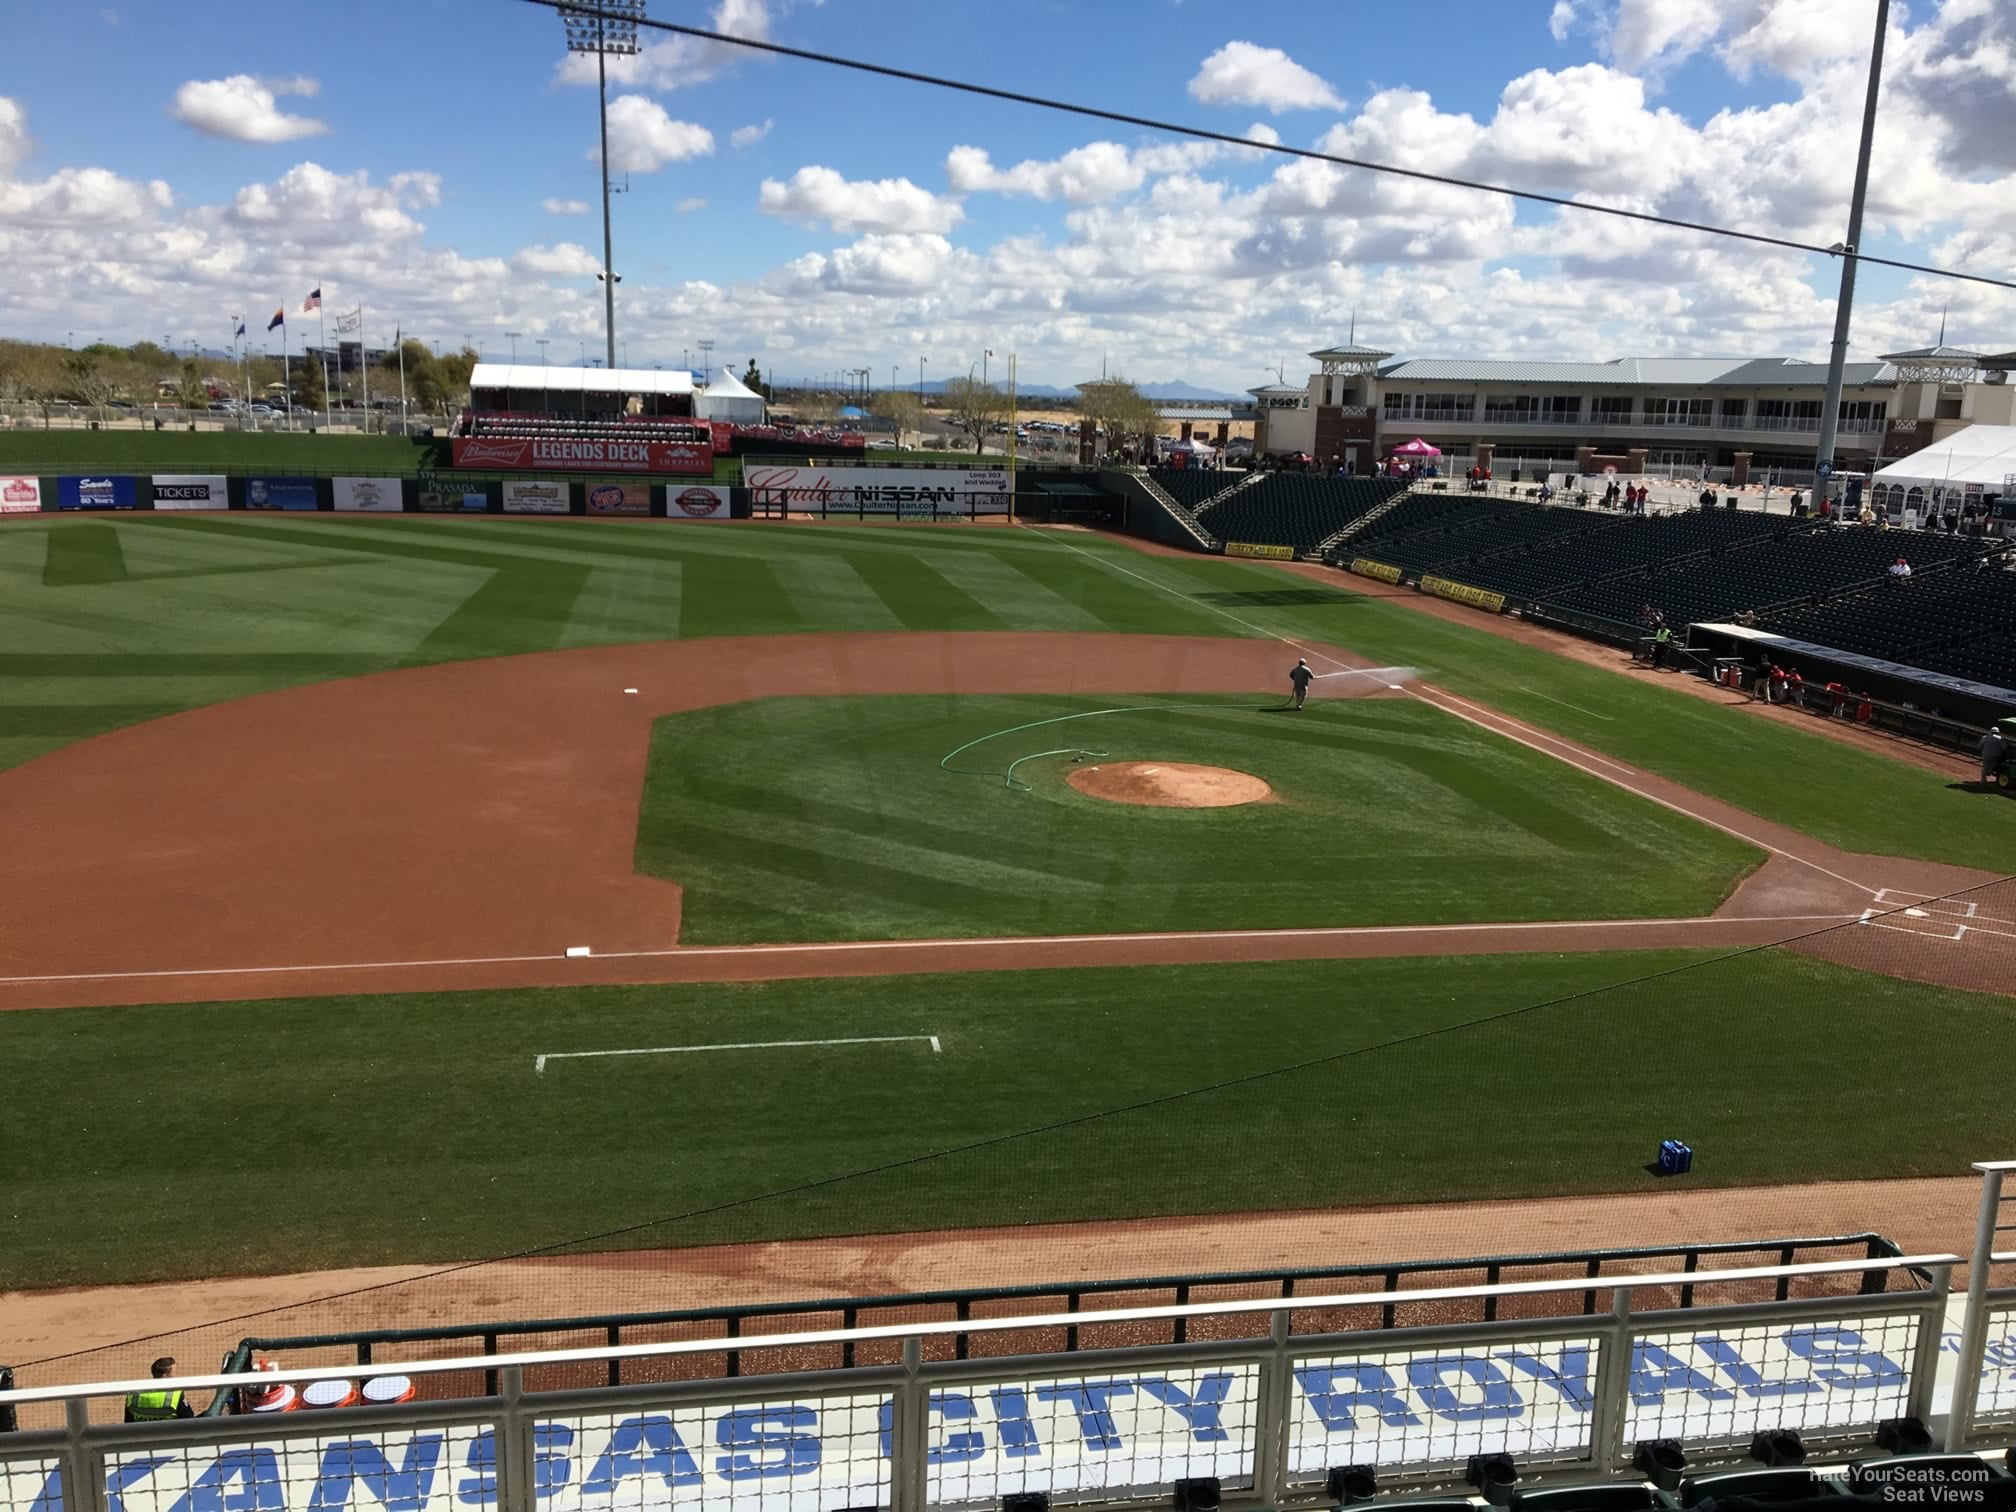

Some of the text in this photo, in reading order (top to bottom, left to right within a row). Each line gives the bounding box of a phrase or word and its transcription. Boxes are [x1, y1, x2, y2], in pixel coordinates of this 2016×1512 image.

[464, 446, 520, 457] Budweiser
[533, 443, 649, 461] LEGENDS DECK
[428, 480, 476, 493] PRASADA
[749, 468, 849, 505] Coulter
[854, 486, 955, 502] NISSAN
[27, 1405, 822, 1512] KANSAS
[876, 1372, 1235, 1465] CITY
[1294, 1326, 1907, 1433] ROYALS
